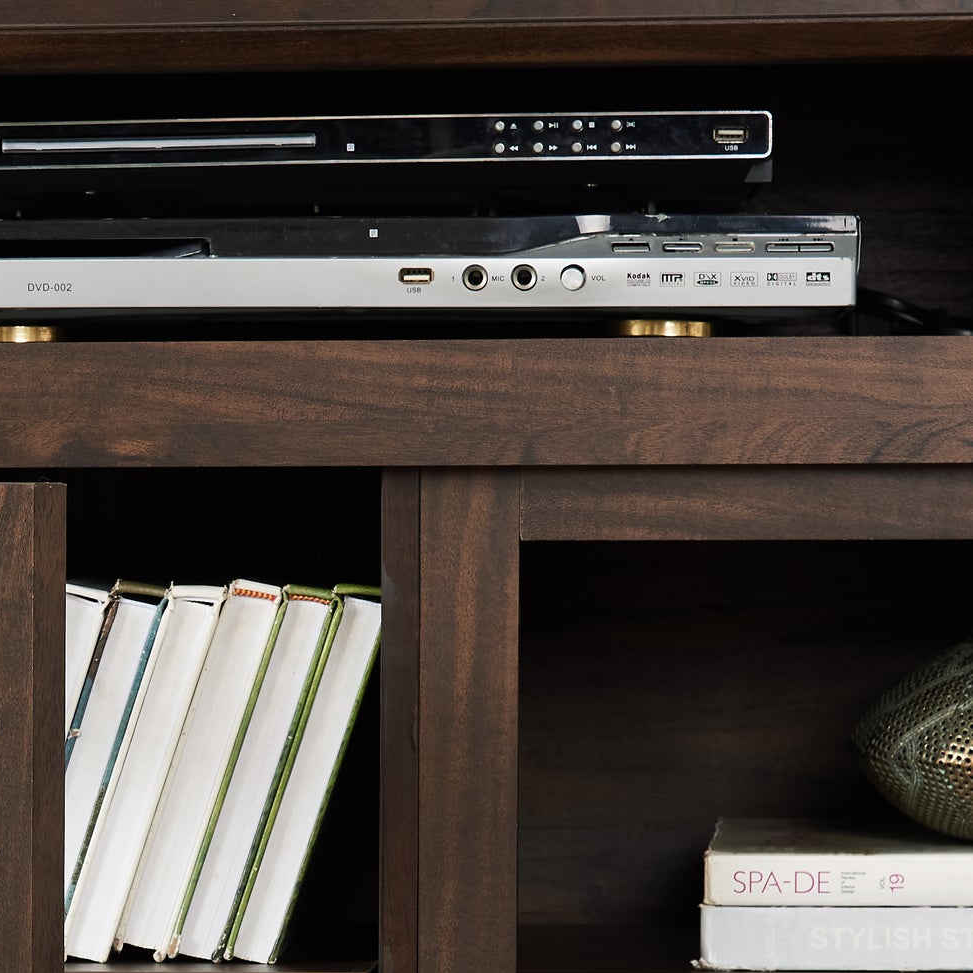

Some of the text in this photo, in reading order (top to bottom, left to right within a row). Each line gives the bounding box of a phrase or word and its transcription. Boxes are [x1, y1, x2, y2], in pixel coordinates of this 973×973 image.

[26, 282, 73, 292] DVD-002
[406, 286, 422, 294] USB
[732, 869, 831, 894] SPA-DE
[888, 873, 905, 893] 19
[810, 926, 932, 950] STYLISH
